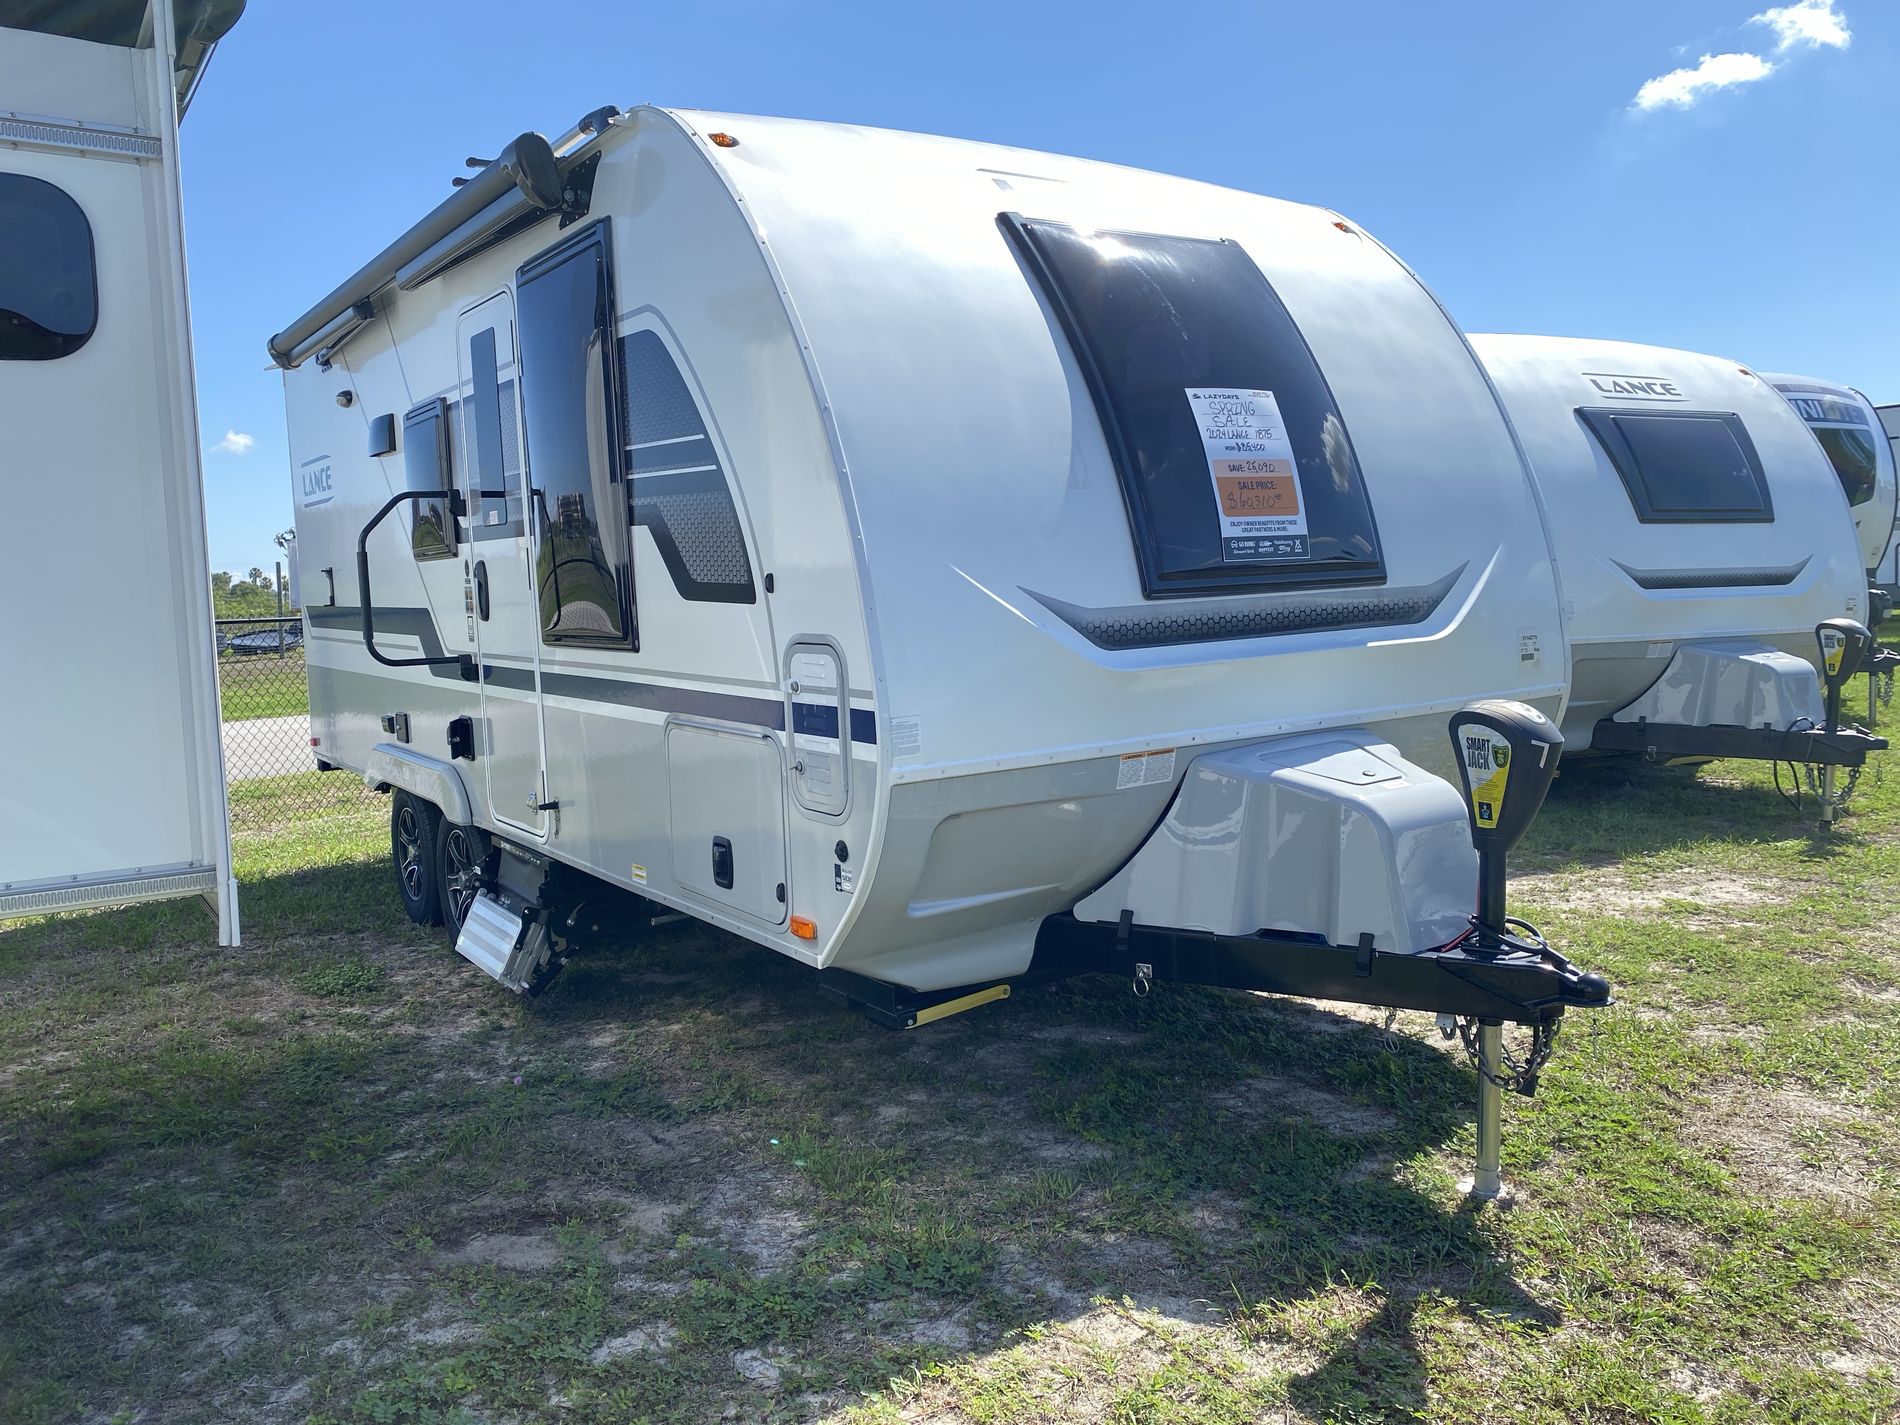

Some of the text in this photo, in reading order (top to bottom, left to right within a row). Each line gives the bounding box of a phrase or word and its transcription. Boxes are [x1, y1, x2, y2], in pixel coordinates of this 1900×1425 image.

[1590, 378, 1682, 397] LANCE
[1209, 401, 1256, 416] SPRING
[1212, 414, 1253, 428] SALE
[1206, 428, 1273, 440] 2024 LANCE 1875
[302, 465, 333, 497] LANCE
[1237, 480, 1255, 490] SALE
[1466, 736, 1491, 753] SMART
[1467, 752, 1491, 771] JACK
